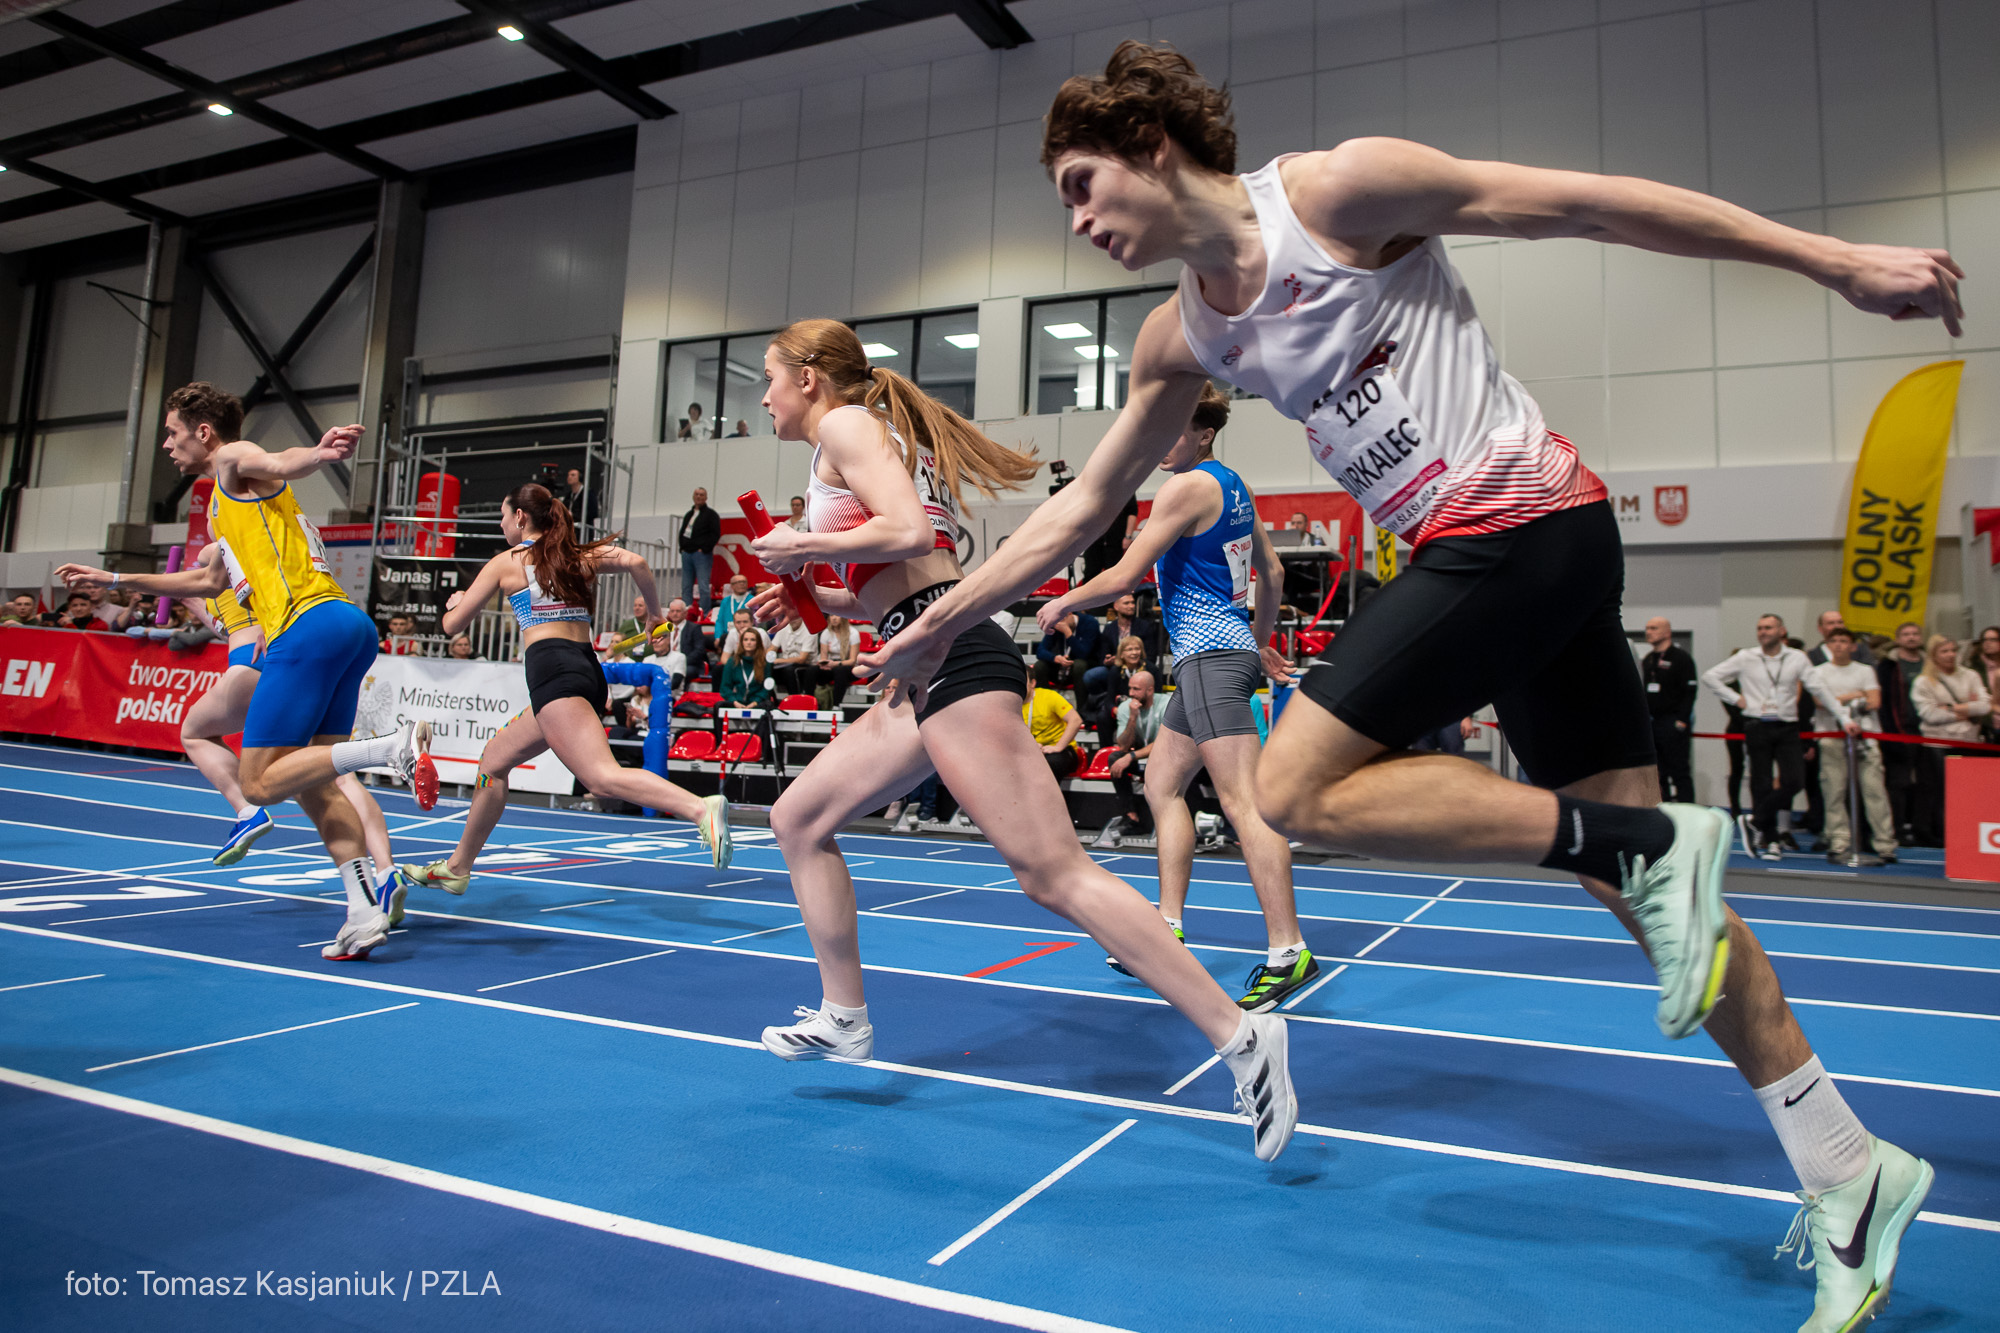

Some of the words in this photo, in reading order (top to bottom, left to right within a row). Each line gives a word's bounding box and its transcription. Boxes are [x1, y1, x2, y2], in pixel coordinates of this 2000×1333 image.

[1336, 377, 1382, 428] 120
[1337, 417, 1420, 500] DURKALEC
[1850, 488, 1890, 608] DOLNY
[380, 568, 432, 584] Janas
[405, 603, 419, 613] 25
[421, 603, 438, 614] lat
[0, 658, 56, 698] EN
[128, 658, 227, 697] tworzym
[115, 691, 187, 725] polski
[399, 686, 510, 714] Ministerstwo
[455, 719, 460, 738] i
